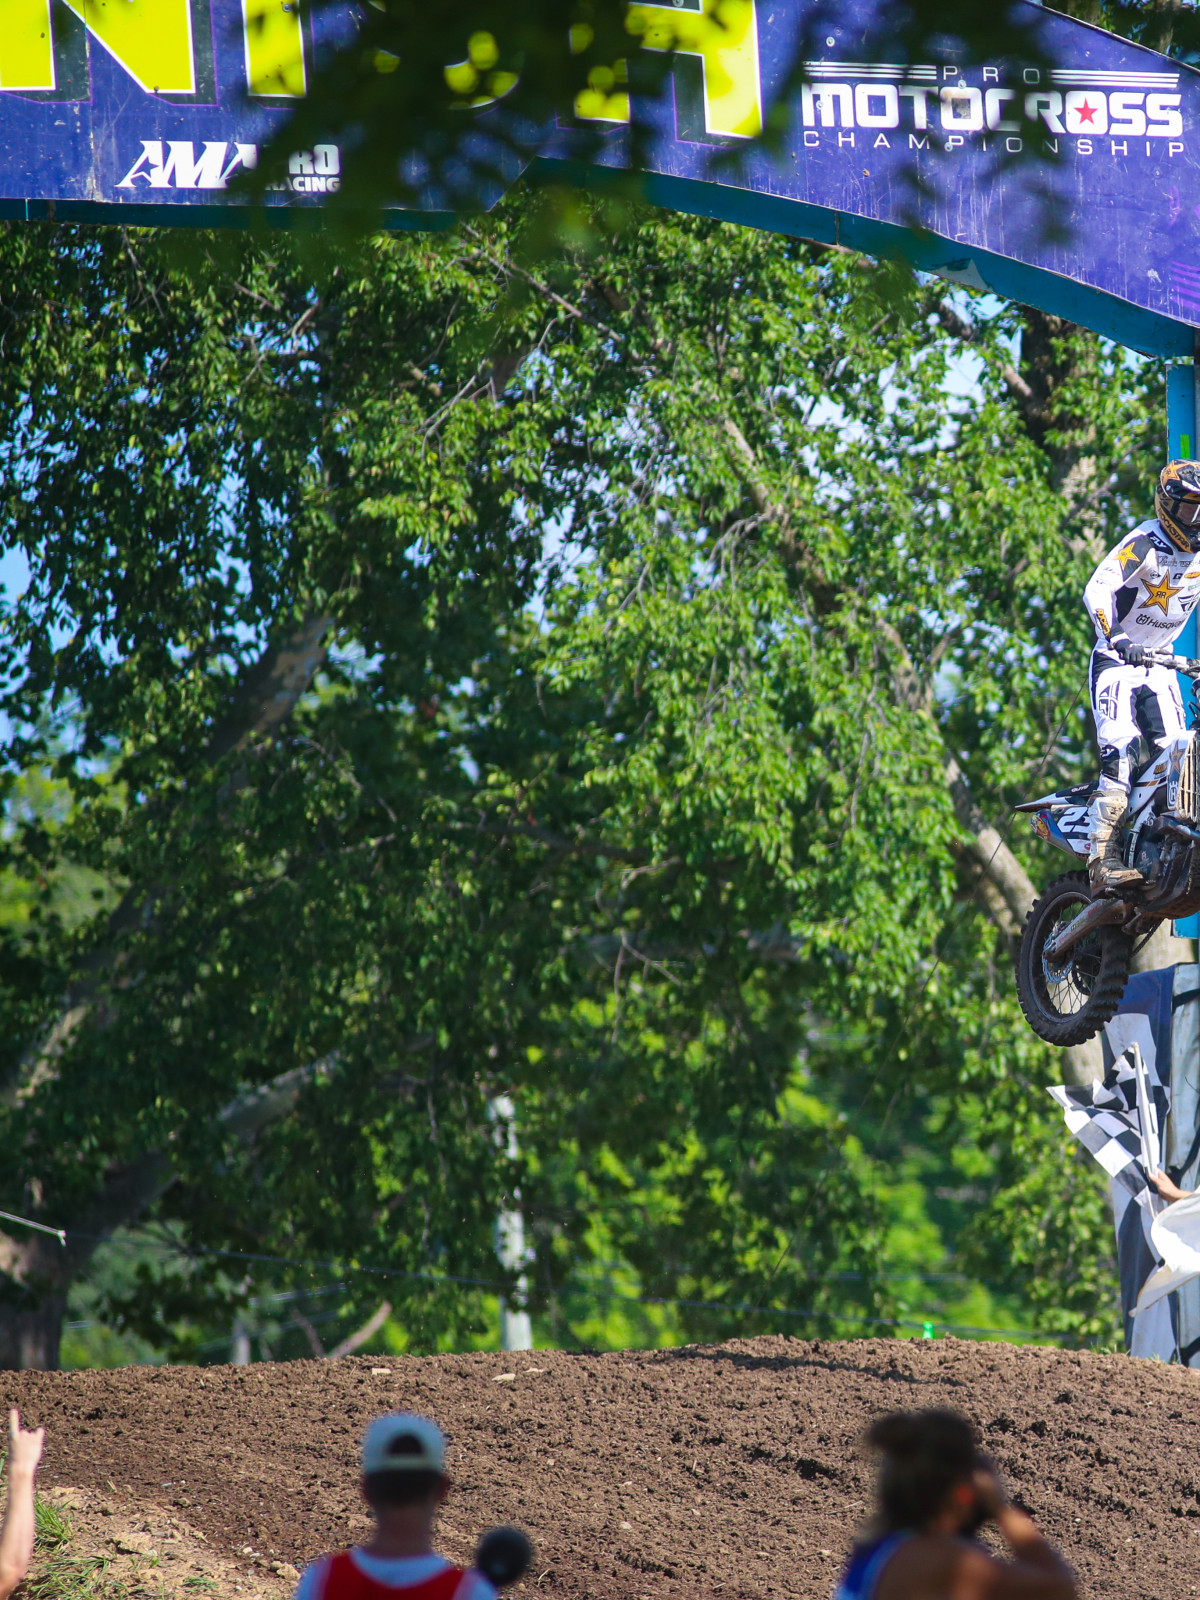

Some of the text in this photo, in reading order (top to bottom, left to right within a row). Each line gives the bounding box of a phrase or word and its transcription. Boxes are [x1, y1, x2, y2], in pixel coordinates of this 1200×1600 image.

[943, 66, 1040, 84] PRO
[802, 83, 1183, 137] MOTOCROSS
[803, 130, 1184, 157] CHAMPIONSHIP
